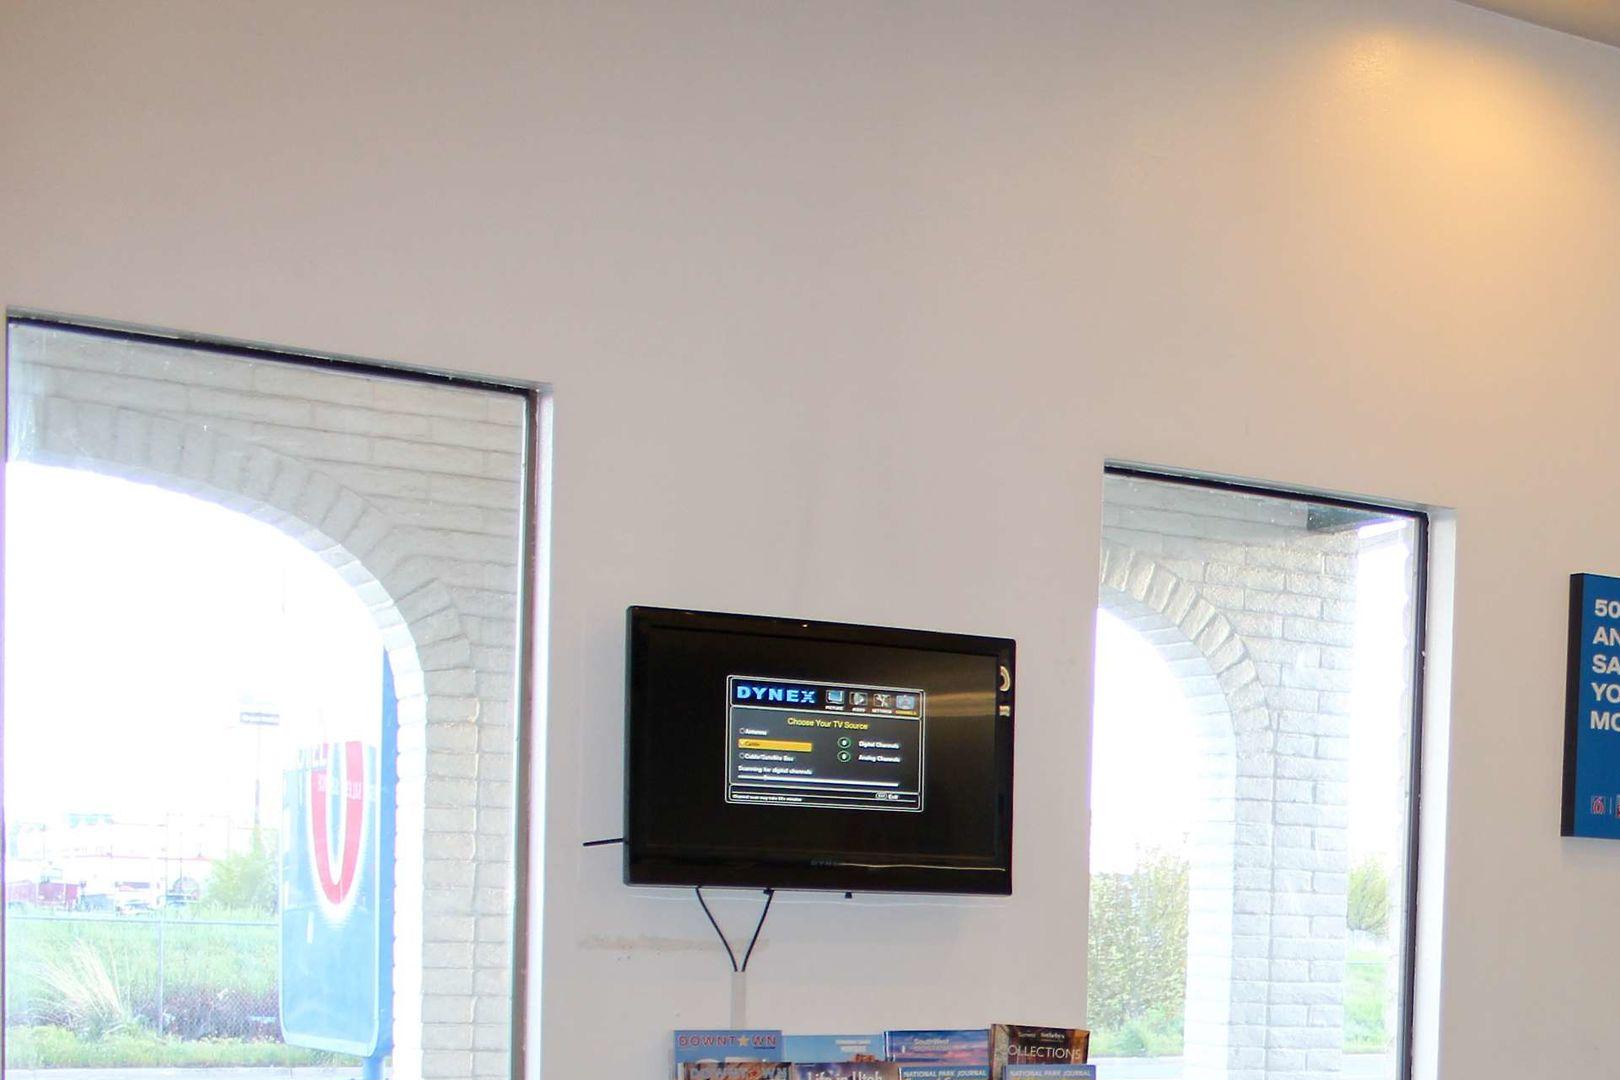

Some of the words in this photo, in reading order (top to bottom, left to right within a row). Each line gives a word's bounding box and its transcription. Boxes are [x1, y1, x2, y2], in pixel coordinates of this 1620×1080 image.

[736, 685, 816, 704] DYNEX
[787, 717, 815, 727] Choose
[815, 719, 832, 728] Your
[833, 720, 844, 729] TV
[844, 721, 869, 730] Source
